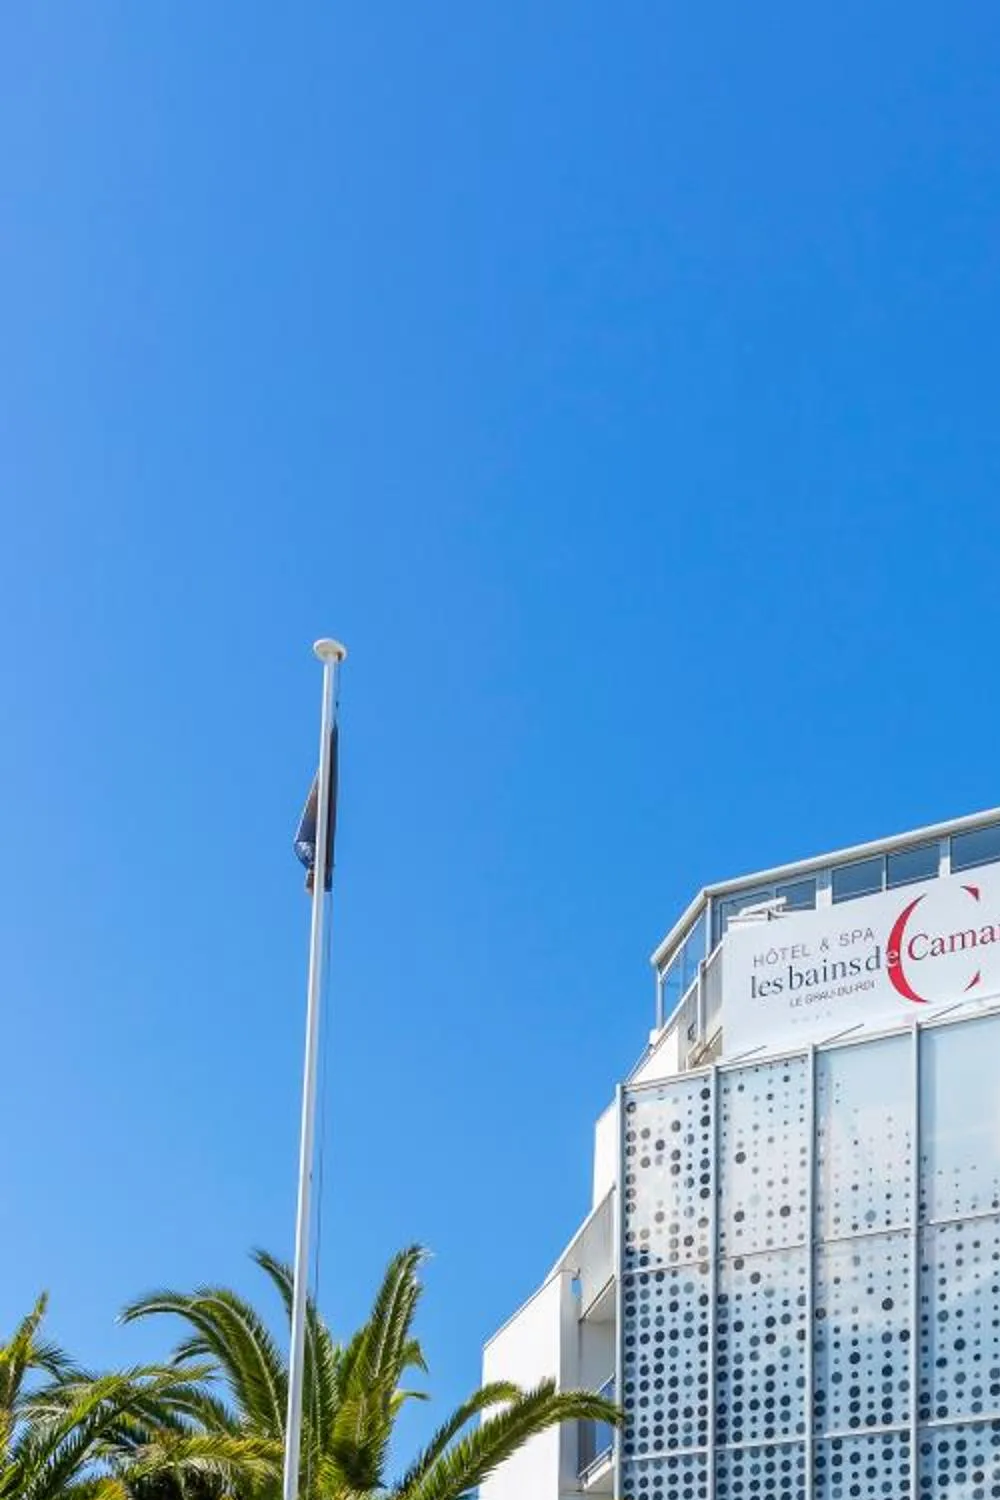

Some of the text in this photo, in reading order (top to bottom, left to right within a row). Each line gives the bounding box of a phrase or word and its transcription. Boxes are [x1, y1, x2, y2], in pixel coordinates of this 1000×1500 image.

[753, 928, 875, 968] HÔTEL & SPA
[751, 975, 783, 999] les
[788, 959, 861, 990] bains
[789, 997, 803, 1008] LE
